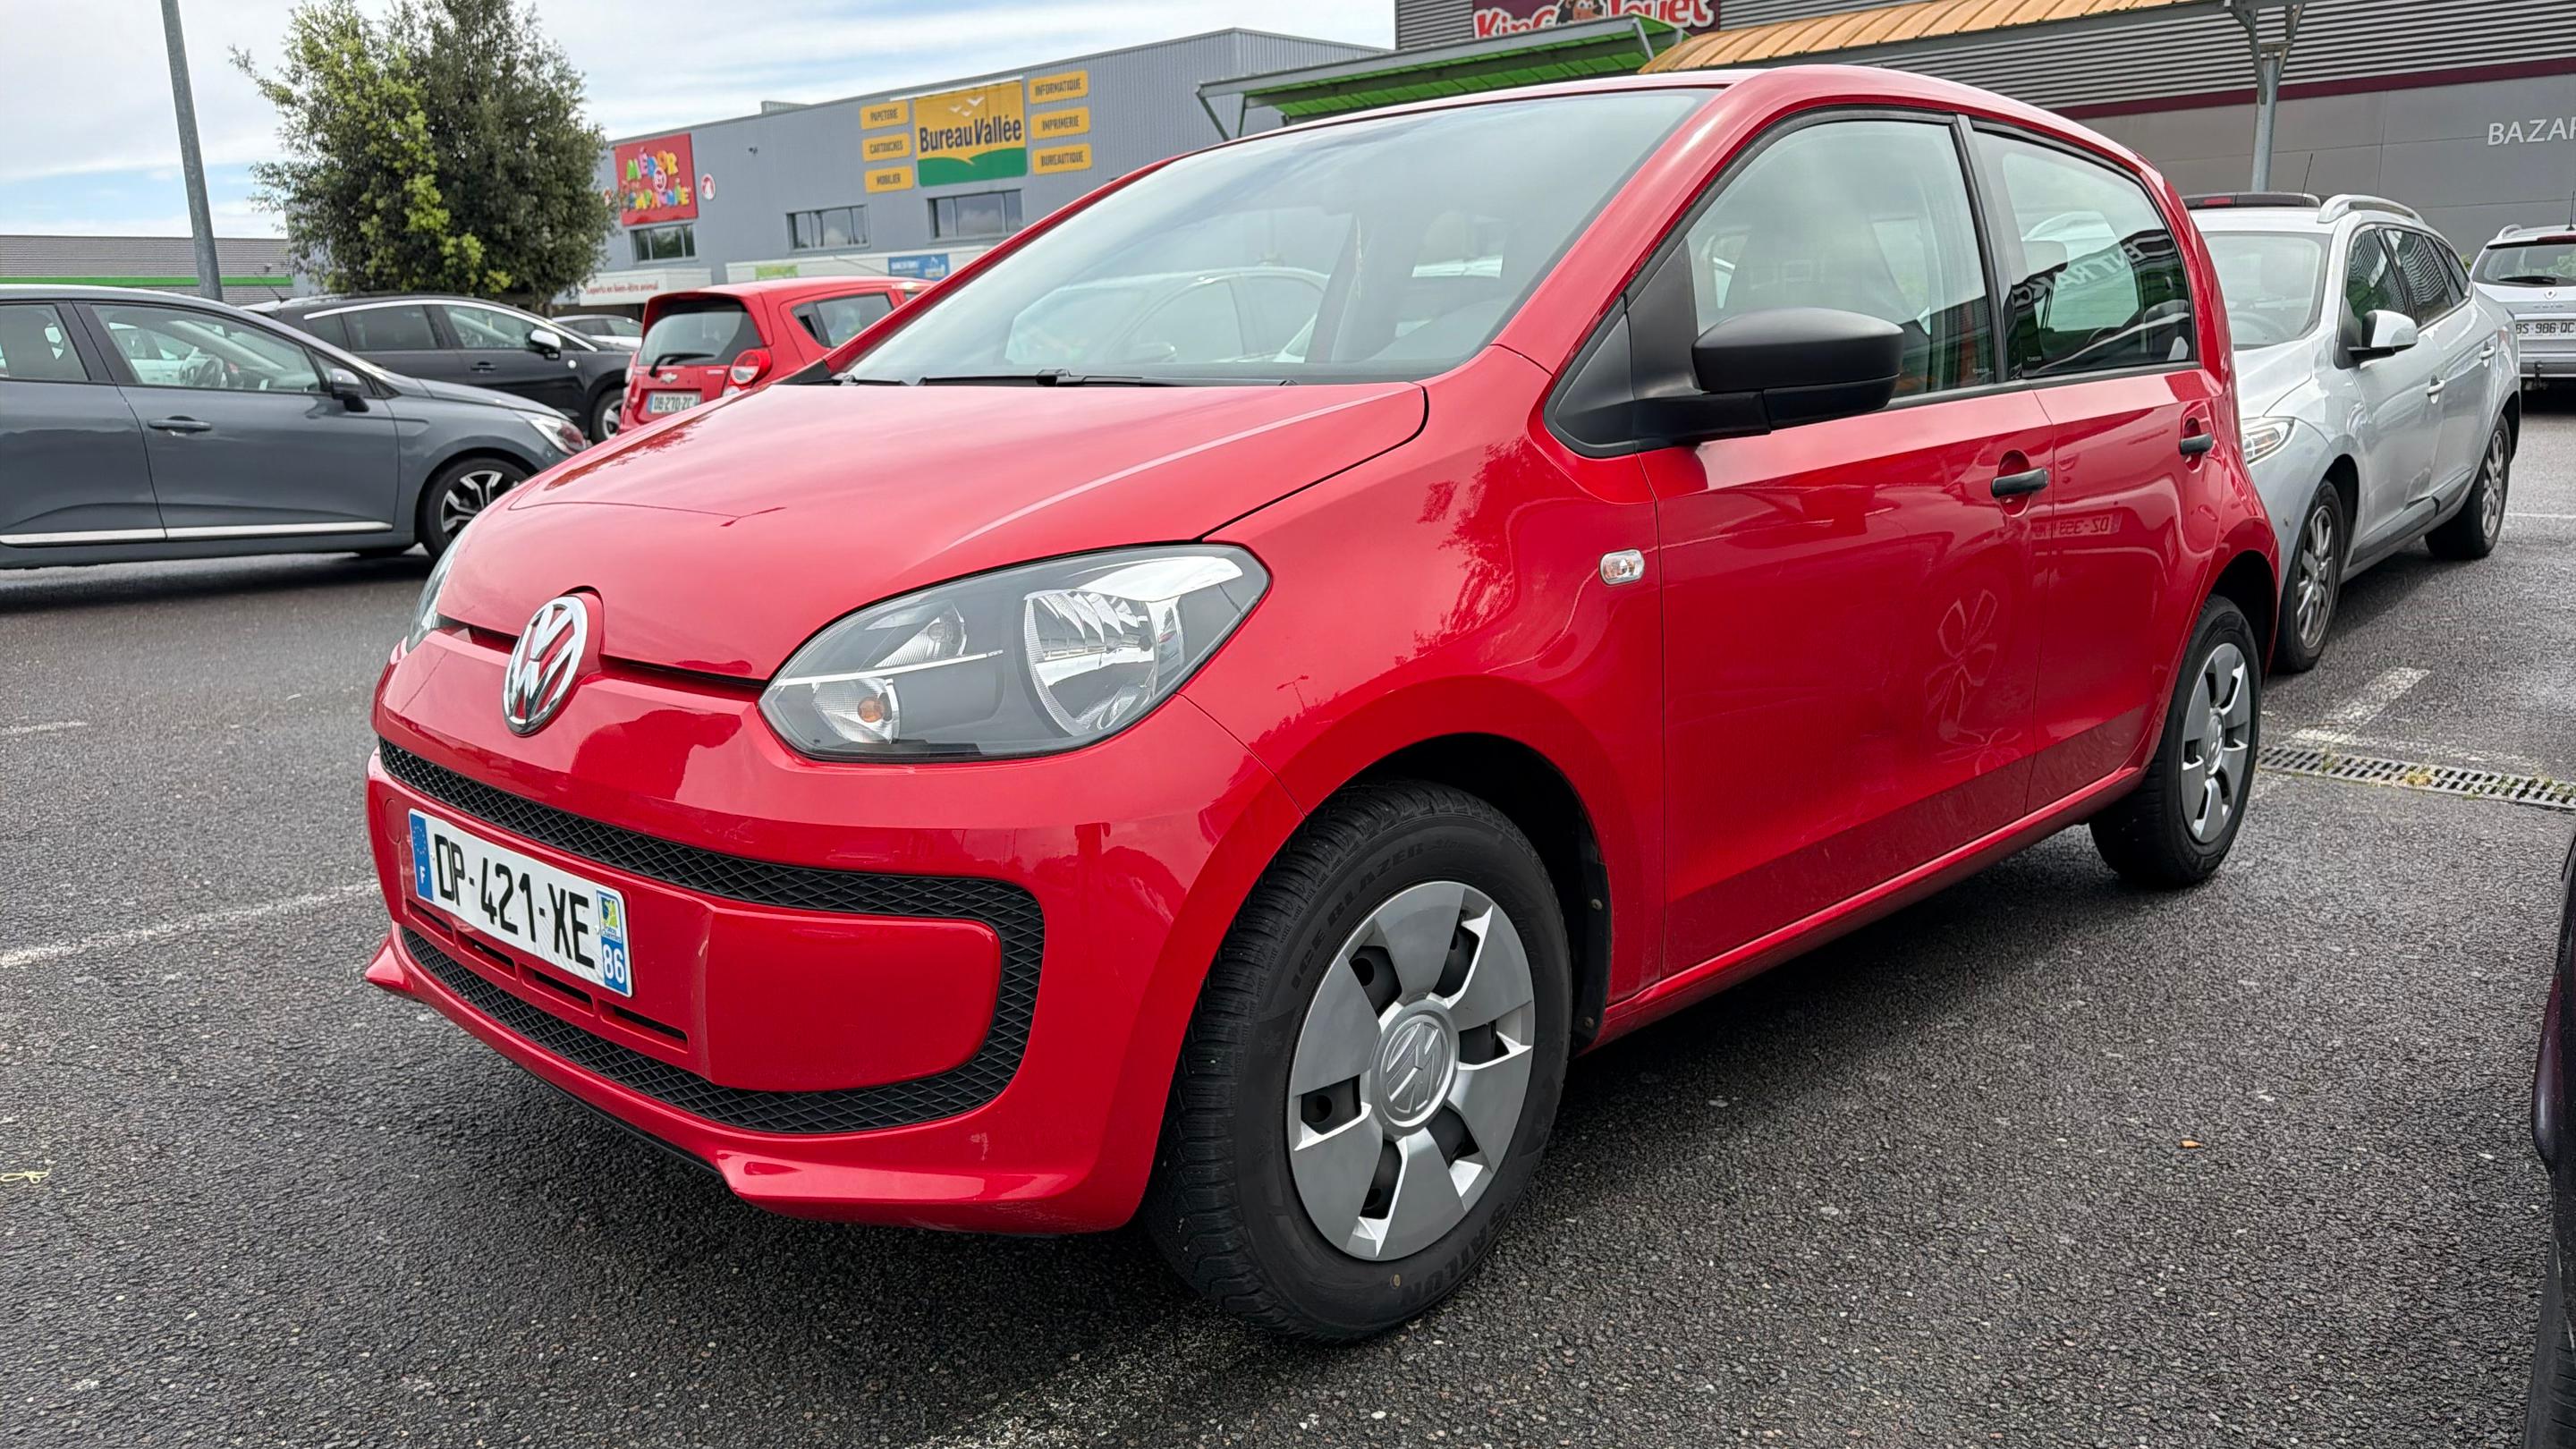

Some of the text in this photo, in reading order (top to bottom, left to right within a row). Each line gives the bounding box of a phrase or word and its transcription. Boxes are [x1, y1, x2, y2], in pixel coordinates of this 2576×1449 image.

[1035, 78, 1081, 96] INFORMATIQUE
[869, 108, 898, 122] PAPETERIE
[1042, 114, 1080, 131] IMPRIMERIE
[869, 140, 903, 154] CARTOUCHES
[1040, 150, 1084, 167] BUREAUTIQUE
[876, 173, 902, 185] MOBILIER
[621, 178, 691, 211] OMPAGNIE
[419, 865, 427, 885] F
[434, 833, 596, 970] DP-421-XE
[603, 944, 625, 984] 86
